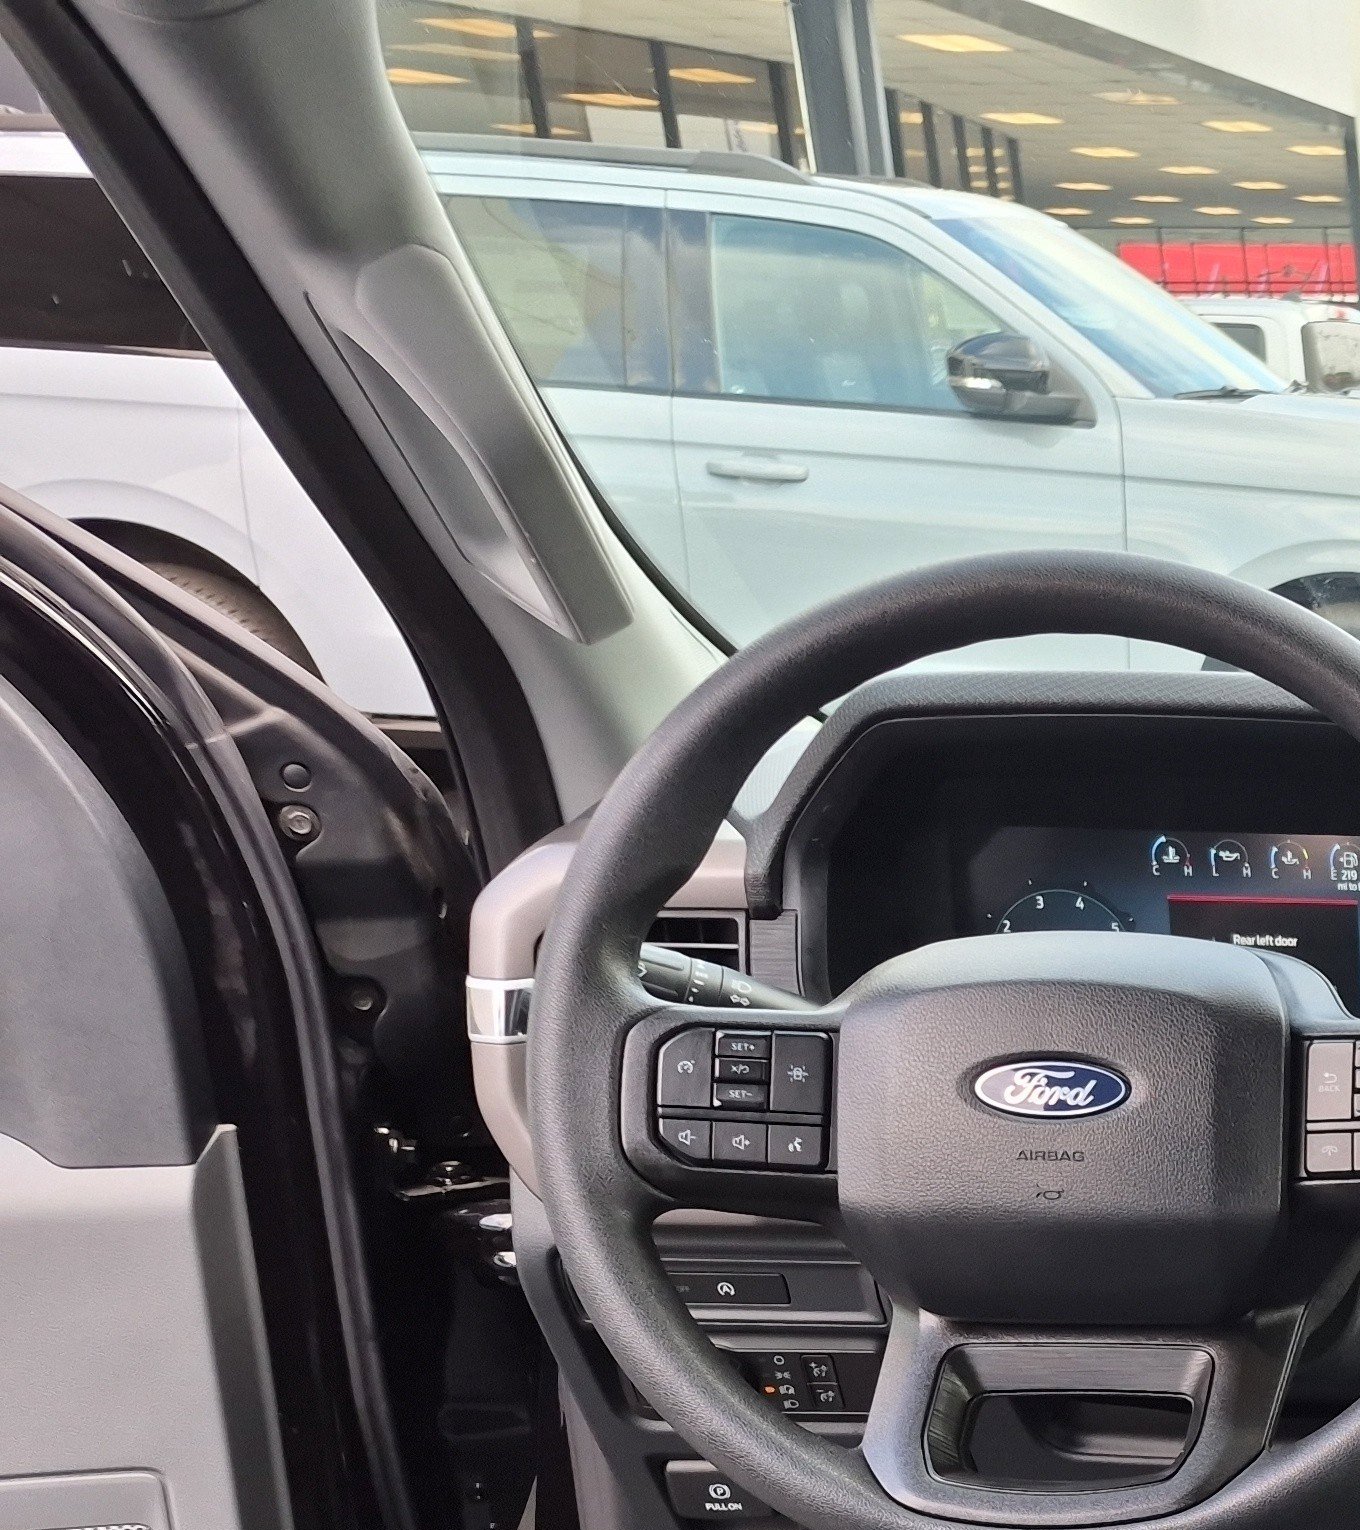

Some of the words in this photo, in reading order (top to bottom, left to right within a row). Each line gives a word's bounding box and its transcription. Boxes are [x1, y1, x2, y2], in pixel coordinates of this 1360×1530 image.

[1152, 865, 1161, 876] C
[1183, 866, 1193, 877] H
[1212, 866, 1220, 877] L
[1242, 867, 1252, 878] H
[1271, 868, 1280, 879] C
[1303, 869, 1312, 880] H
[1330, 869, 1338, 881] E
[1341, 870, 1358, 881] 219
[1349, 882, 1358, 891] to
[1035, 895, 1045, 909] 3
[1075, 896, 1085, 911] 4
[1002, 920, 1012, 933] 2
[1111, 922, 1120, 933] 5
[1232, 933, 1256, 946] Rear
[1256, 934, 1274, 946] left
[1275, 935, 1298, 947] door
[1003, 1068, 1098, 1107] Ford
[1318, 1084, 1341, 1093] BACK
[1016, 1150, 1086, 1162] AIRBAG
[705, 1502, 728, 1511] PULL
[727, 1502, 743, 1511] ON
